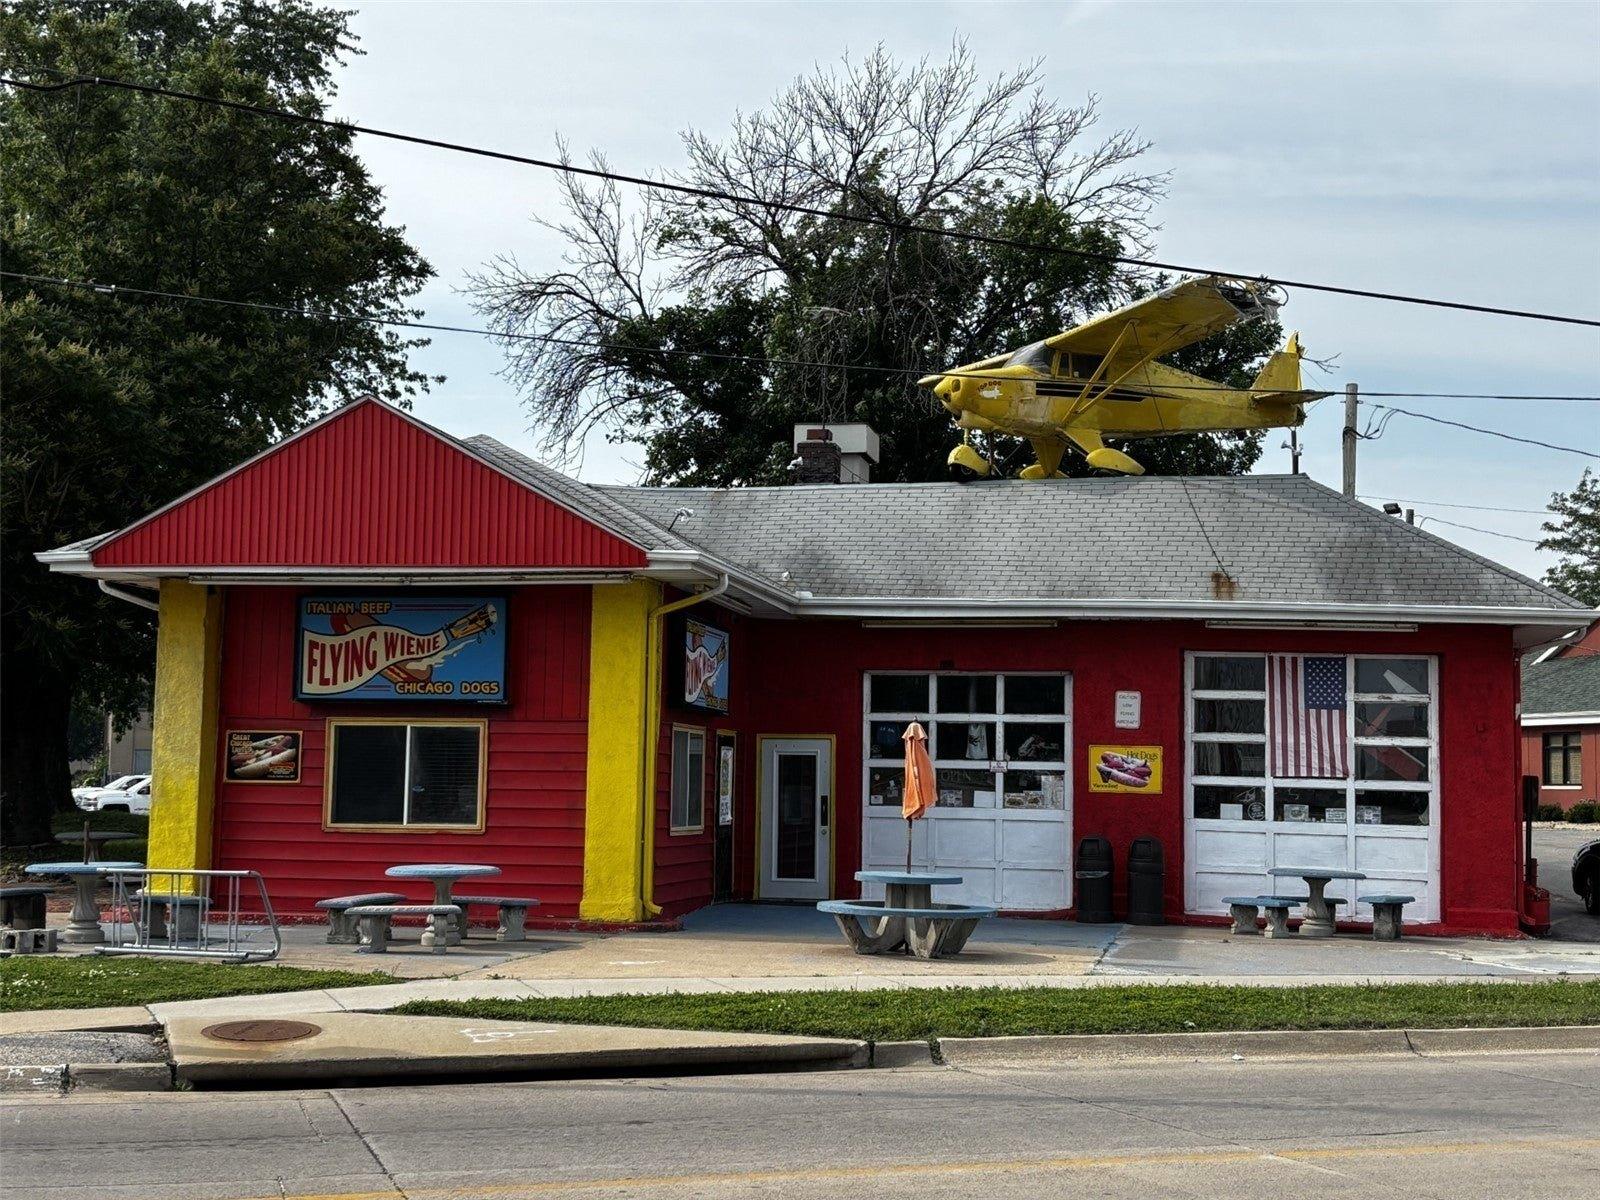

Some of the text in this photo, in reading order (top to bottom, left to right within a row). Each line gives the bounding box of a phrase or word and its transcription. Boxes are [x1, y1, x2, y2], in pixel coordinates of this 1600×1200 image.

[307, 602, 391, 614] ITALIAN BEEF
[307, 631, 441, 686] FLYING WIENIE
[395, 682, 499, 694] CHICAGO DOGS
[1126, 751, 1159, 760] Hot Dogs
